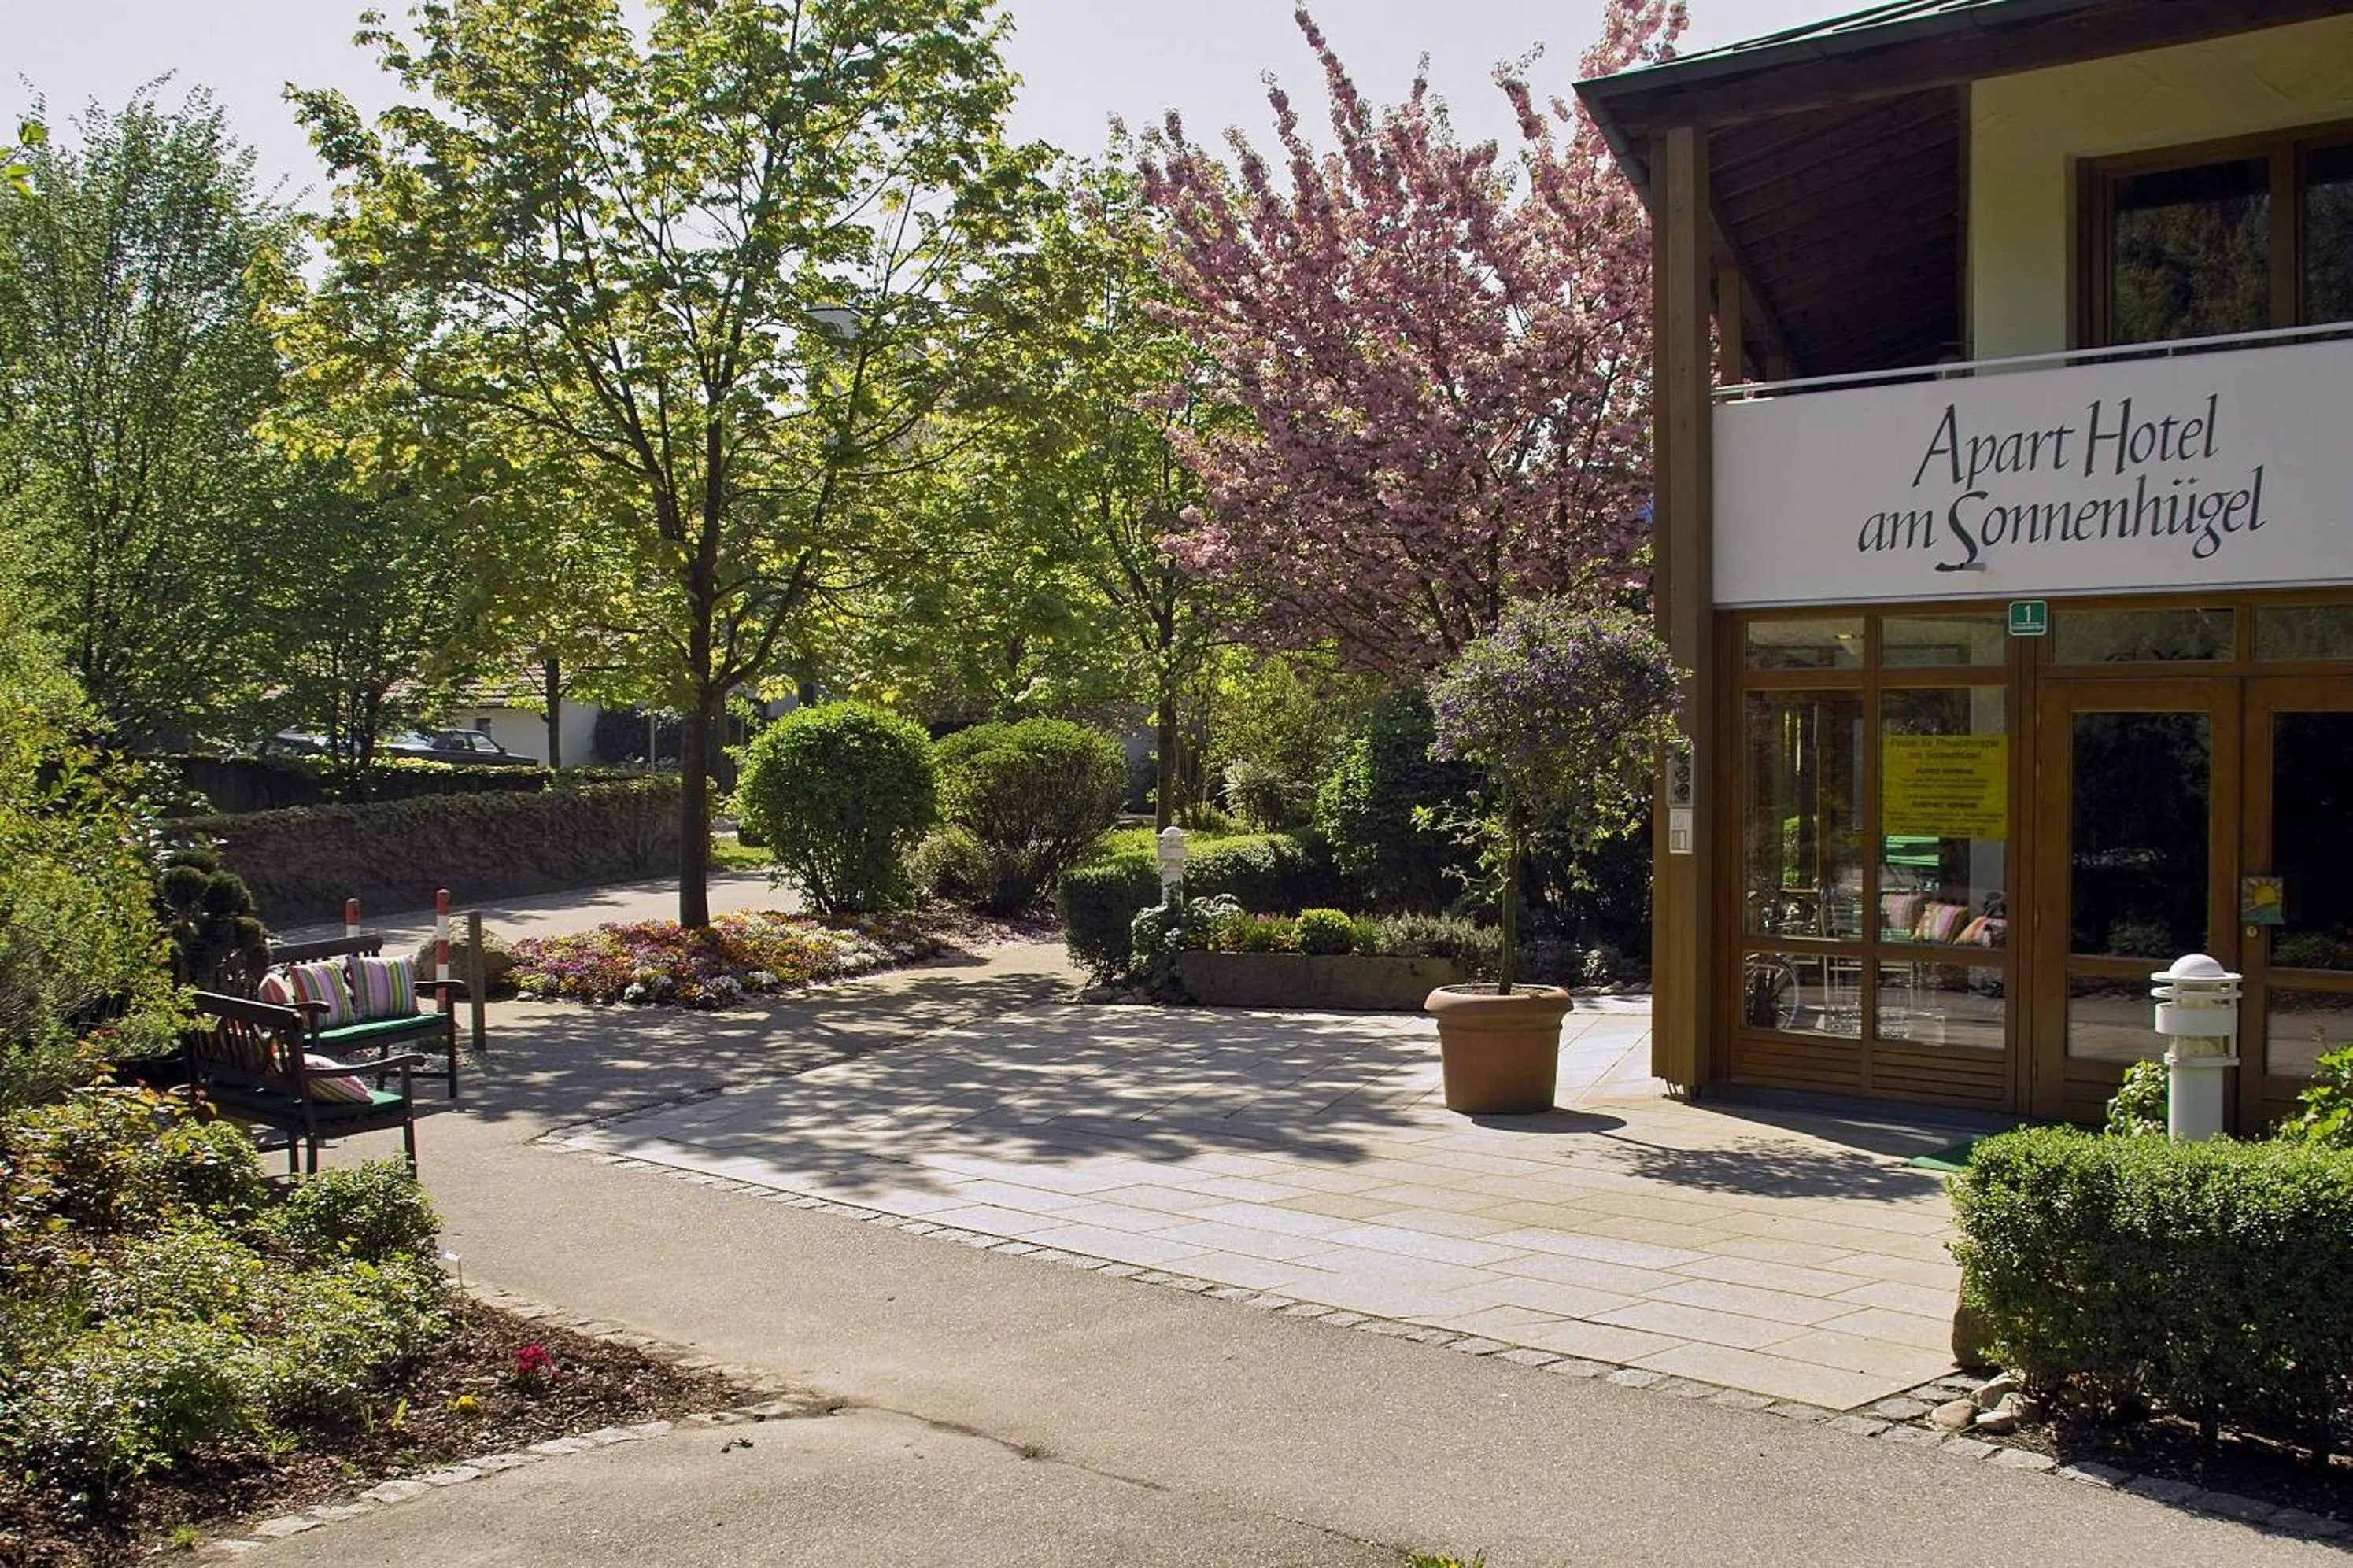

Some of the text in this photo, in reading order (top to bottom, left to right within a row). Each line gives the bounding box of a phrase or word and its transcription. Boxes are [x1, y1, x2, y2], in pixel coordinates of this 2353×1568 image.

[1911, 392, 2220, 492] Apart Hotel
[1856, 463, 2268, 574] am Sonnenhügel
[2024, 604, 2031, 622] 1
